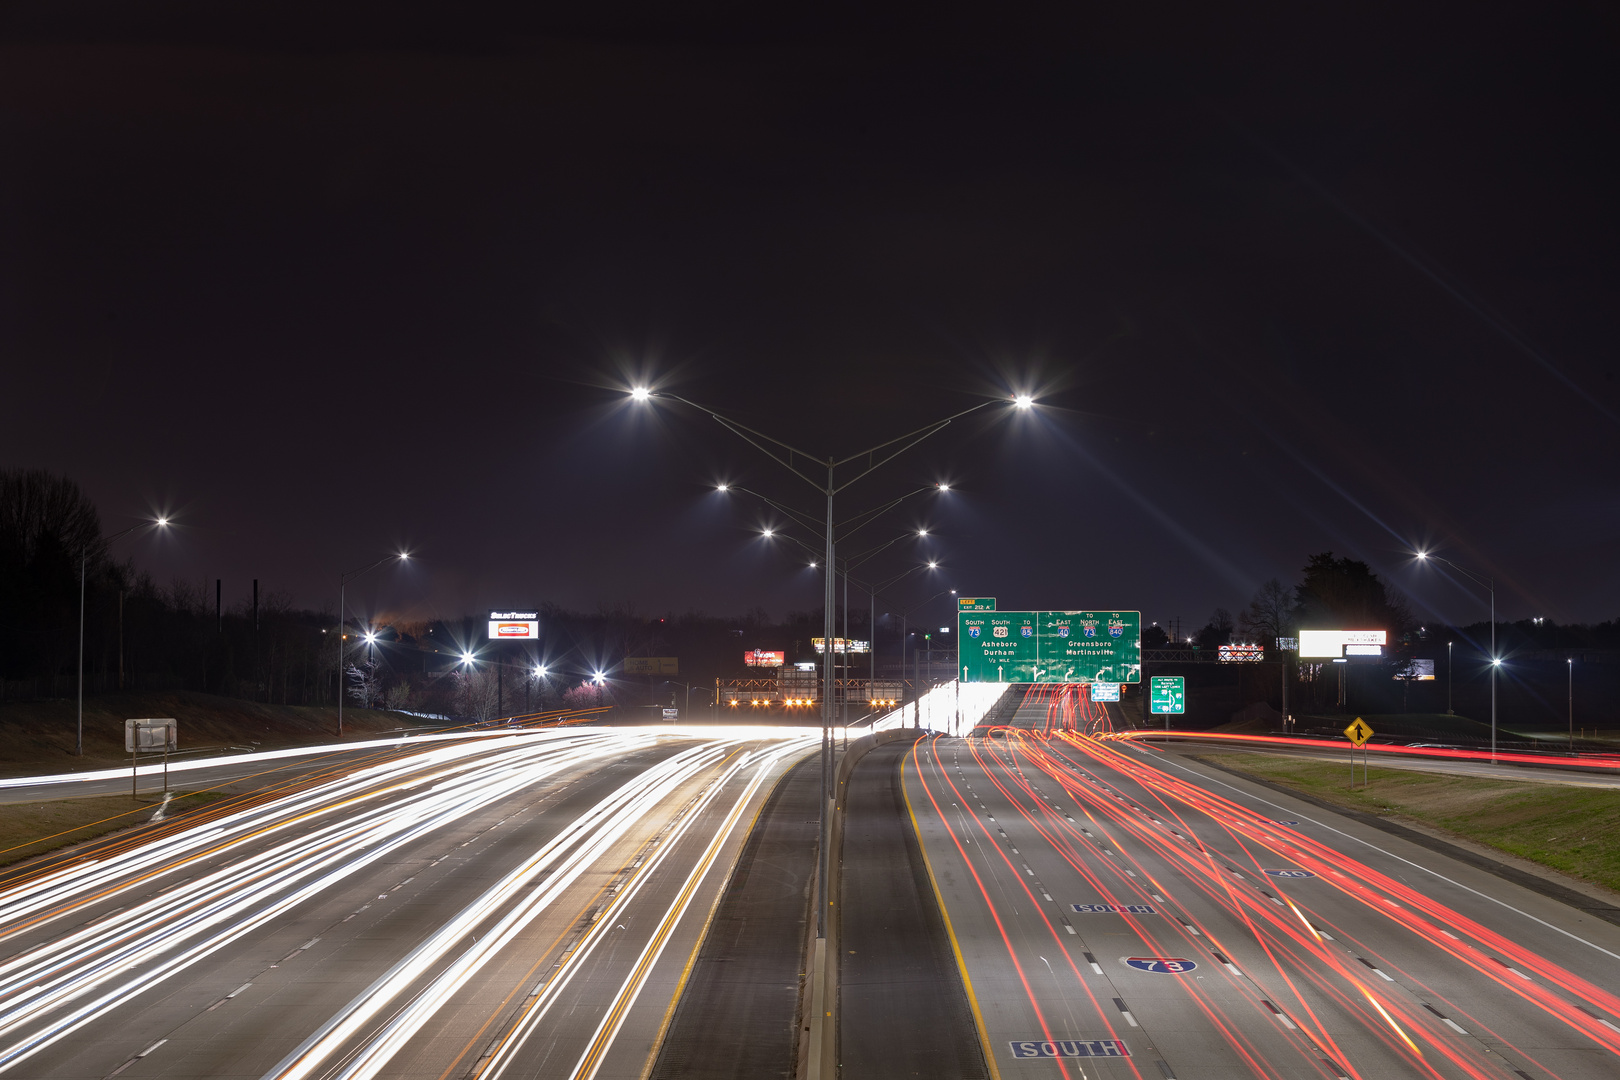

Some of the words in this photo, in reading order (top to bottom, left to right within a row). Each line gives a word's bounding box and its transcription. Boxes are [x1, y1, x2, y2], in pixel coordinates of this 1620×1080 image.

[1079, 904, 1153, 913] SOUTH
[1141, 961, 1184, 972] 73
[1019, 1042, 1116, 1057] SOUTH
